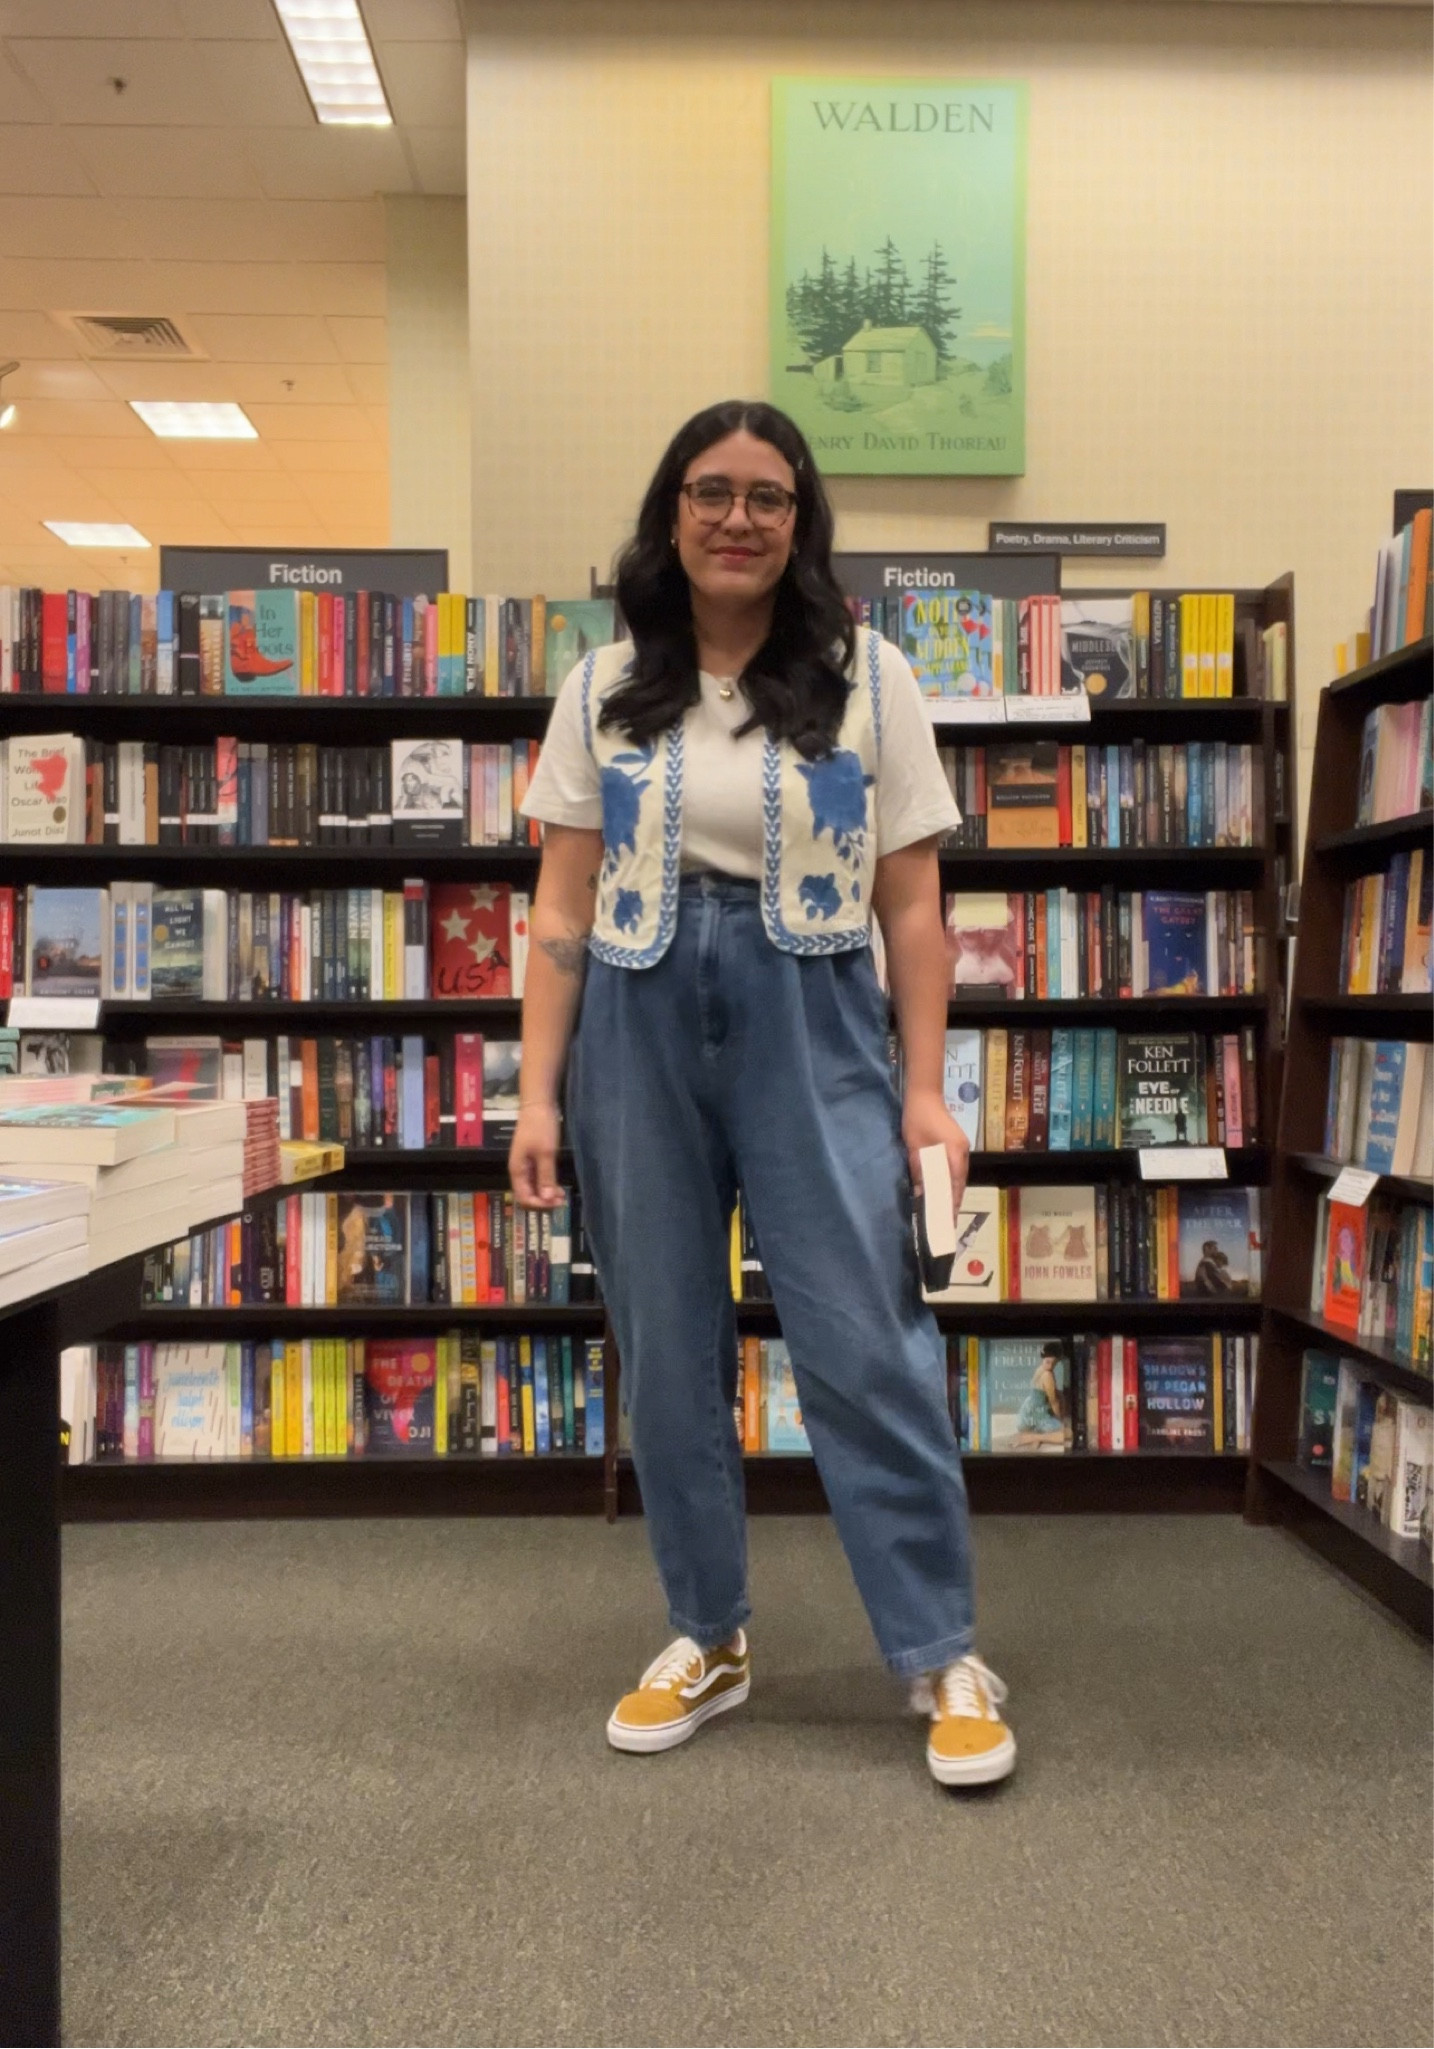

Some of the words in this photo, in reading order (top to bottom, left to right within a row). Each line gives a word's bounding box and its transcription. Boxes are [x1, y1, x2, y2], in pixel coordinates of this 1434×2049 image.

[812, 100, 995, 134] WALDEN
[811, 433, 854, 450] ENRY
[863, 431, 919, 451] DAVID
[925, 431, 1007, 451] THOREAU
[996, 532, 1032, 547] Poetry,
[1032, 532, 1073, 546] Drama,
[1072, 532, 1113, 547] Literary
[1113, 532, 1160, 546] Criticism
[269, 563, 344, 585] Fiction
[884, 566, 956, 588] Fiction
[259, 604, 277, 621] In
[256, 622, 285, 639] Her
[466, 631, 475, 665] ANON
[18, 748, 38, 758] The
[11, 796, 43, 808] Oscar
[12, 827, 43, 838] Junot
[164, 904, 180, 913] ALL
[181, 902, 195, 912] THE
[169, 915, 192, 925] LIGHT
[1160, 916, 1197, 925] GATSBY
[1026, 922, 1035, 942] LOVE
[1013, 1034, 1025, 1057] KEN
[1144, 1045, 1175, 1059] KEN
[1128, 1058, 1192, 1074] FOLLETT
[1012, 1058, 1025, 1101] FOLLETT
[1138, 1081, 1170, 1095] EYE
[1135, 1096, 1190, 1115] NEEDLE
[1193, 1205, 1235, 1217] AFTER
[1185, 1218, 1209, 1229] THE
[1214, 1218, 1243, 1229] WAR
[1024, 1264, 1049, 1279] JOHN
[1052, 1264, 1093, 1280] FOWLES
[371, 1357, 398, 1370] THE
[1143, 1364, 1207, 1377] SHADOWS
[387, 1375, 433, 1388] DEATH
[1144, 1380, 1160, 1392] OF
[1164, 1380, 1207, 1393] PECAN
[1146, 1397, 1205, 1410] HOLLOW
[408, 1426, 432, 1439] OJI
